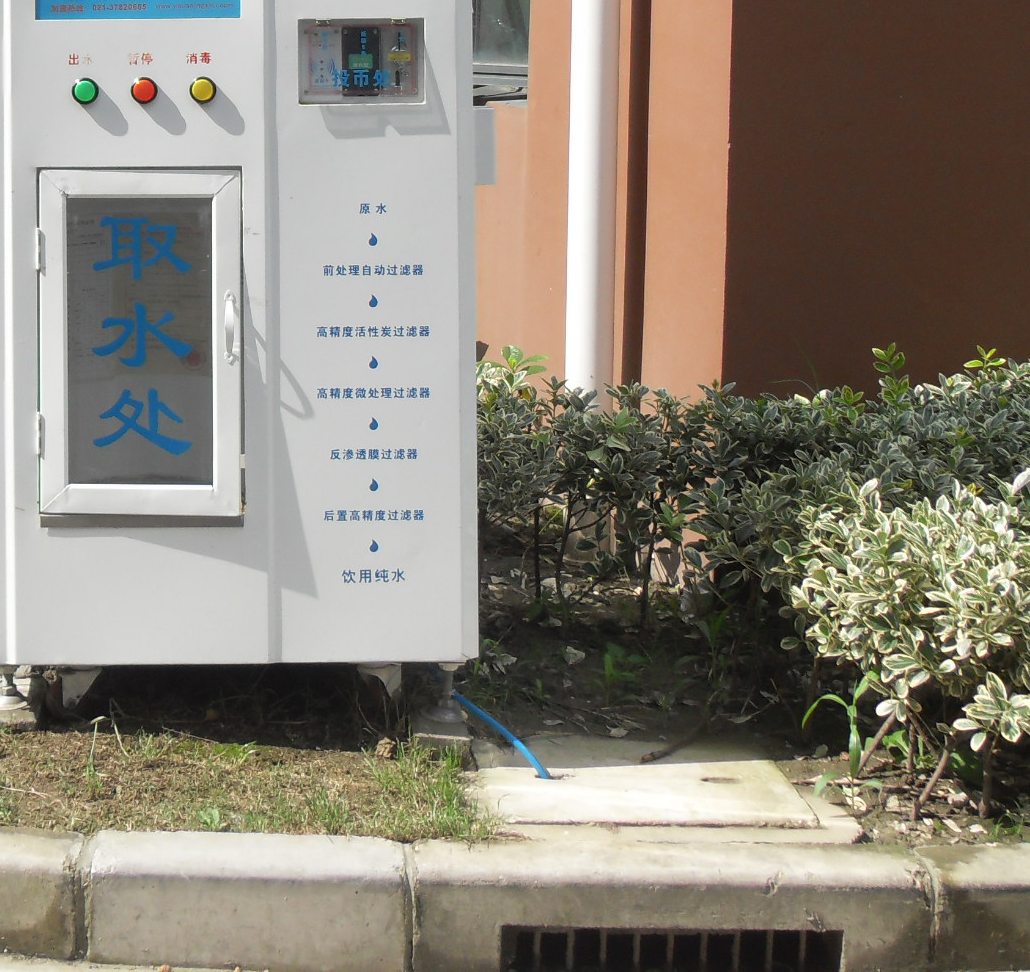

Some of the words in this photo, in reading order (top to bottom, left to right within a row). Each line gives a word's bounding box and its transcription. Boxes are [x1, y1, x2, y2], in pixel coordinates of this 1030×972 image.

[186, 51, 212, 65] 消毒
[359, 203, 387, 214] 原水
[323, 264, 424, 276] 前处理自动过滤器
[92, 215, 194, 455] 取水处
[316, 325, 430, 337] 高精度活性炭过滤器
[317, 387, 430, 399] 高精度微处理过滤器
[330, 448, 418, 460] 反渗透膜过滤器
[323, 509, 425, 521] 后置高精度过滤器
[341, 568, 406, 583] 饮用纯水
